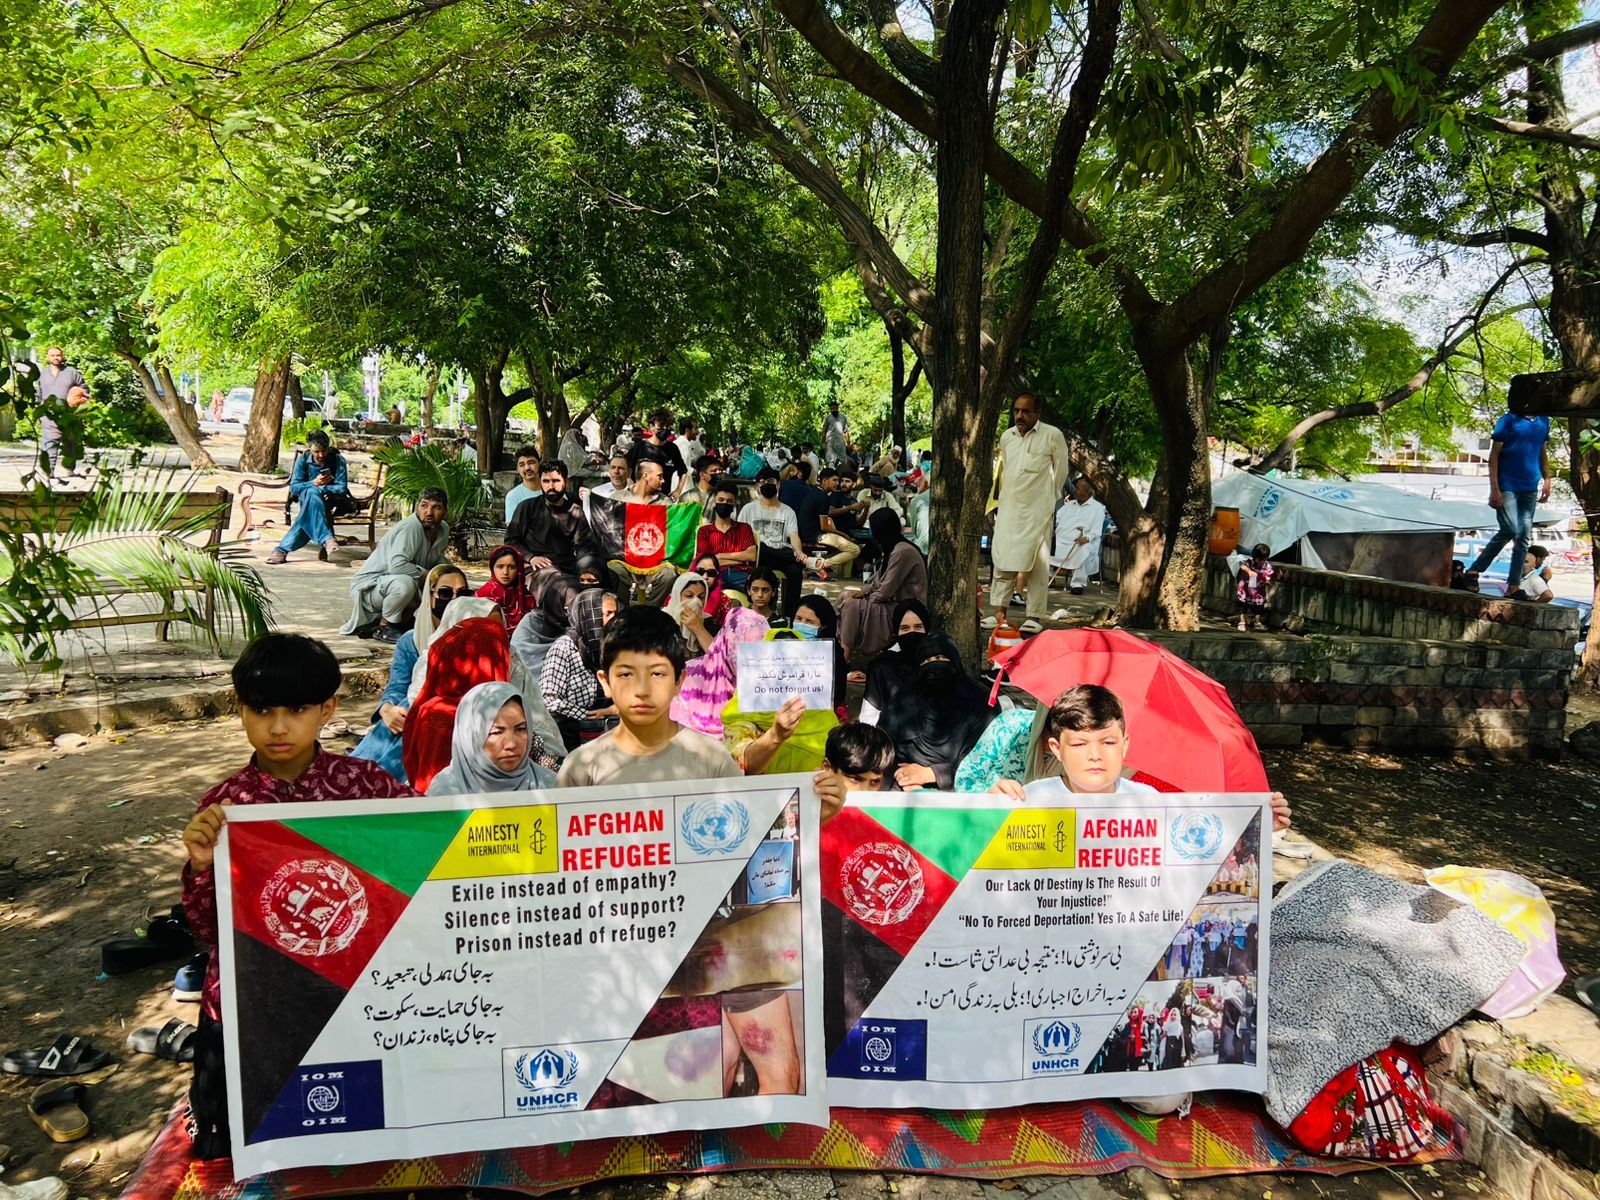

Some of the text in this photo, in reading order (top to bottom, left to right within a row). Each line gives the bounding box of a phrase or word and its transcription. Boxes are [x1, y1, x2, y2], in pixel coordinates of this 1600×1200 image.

[754, 685, 824, 696] Do not forget us!
[567, 809, 664, 837] AFGHAN
[1082, 819, 1158, 838] AFGHAN
[468, 823, 520, 843] AMNESTY
[1006, 824, 1047, 840] AMNESTY
[468, 843, 520, 857] INTERNATIONAL
[1006, 842, 1046, 852] INTERNATIONAL
[562, 843, 672, 872] REFUGEE
[1078, 848, 1162, 868] REFUGEE
[452, 870, 677, 902] Exile instead of empathy?
[986, 875, 1161, 892] Our Lack Of Destiny Is The Result Of
[1037, 896, 1058, 908] Your
[444, 895, 686, 930] Silence instead of support?
[982, 915, 994, 928] To
[997, 914, 1031, 927] Forced
[1034, 912, 1094, 928] Deportation!
[1098, 912, 1114, 924] Yes
[1116, 912, 1127, 924] To
[1128, 911, 1136, 923] A
[1138, 910, 1160, 923] Safe
[1162, 910, 1184, 922] Life!
[456, 921, 676, 954] Prison instead of refuge?
[1032, 1058, 1080, 1070] UNHCR
[300, 1071, 344, 1082] IOM
[516, 1092, 578, 1107] UNHCR
[302, 1116, 348, 1127] OIM
